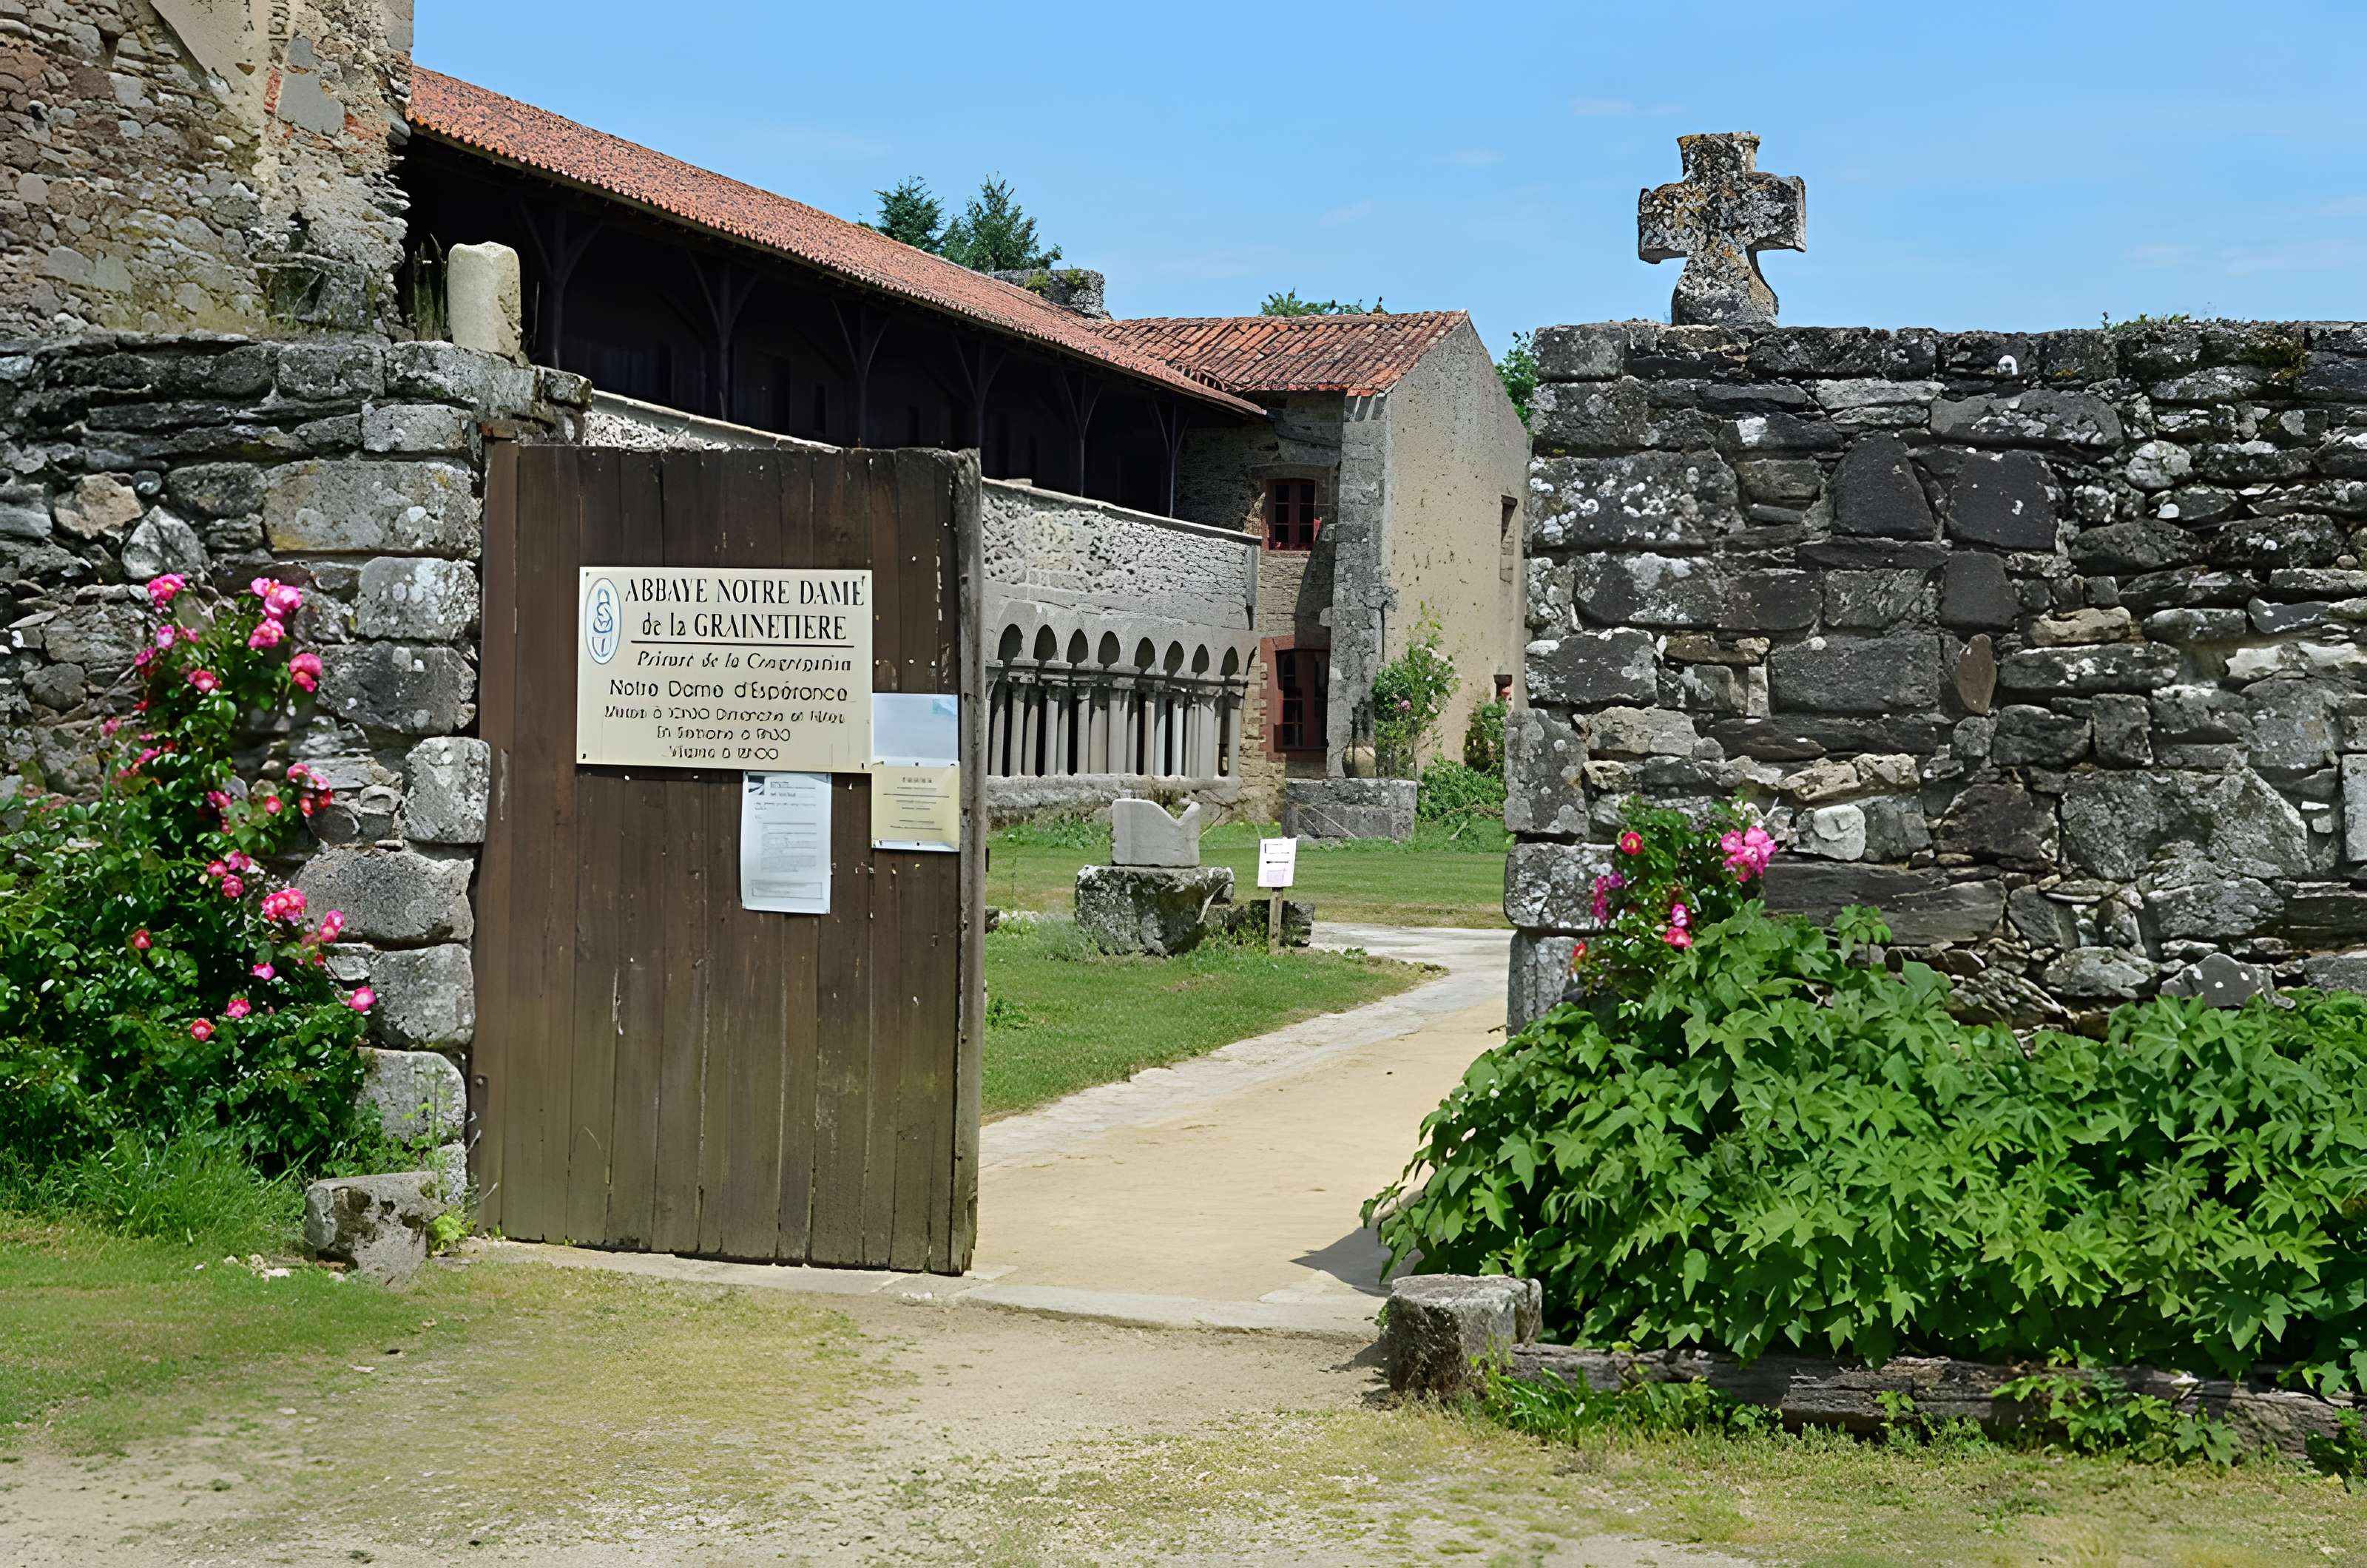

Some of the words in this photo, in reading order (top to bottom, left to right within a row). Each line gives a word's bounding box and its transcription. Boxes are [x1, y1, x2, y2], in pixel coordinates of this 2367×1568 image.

[625, 578, 708, 603] ABBAYE
[717, 578, 790, 604] NOTRE
[800, 578, 865, 606] DAME
[642, 612, 662, 636] de
[670, 612, 686, 637] la
[694, 613, 847, 640] GRAINETIERE
